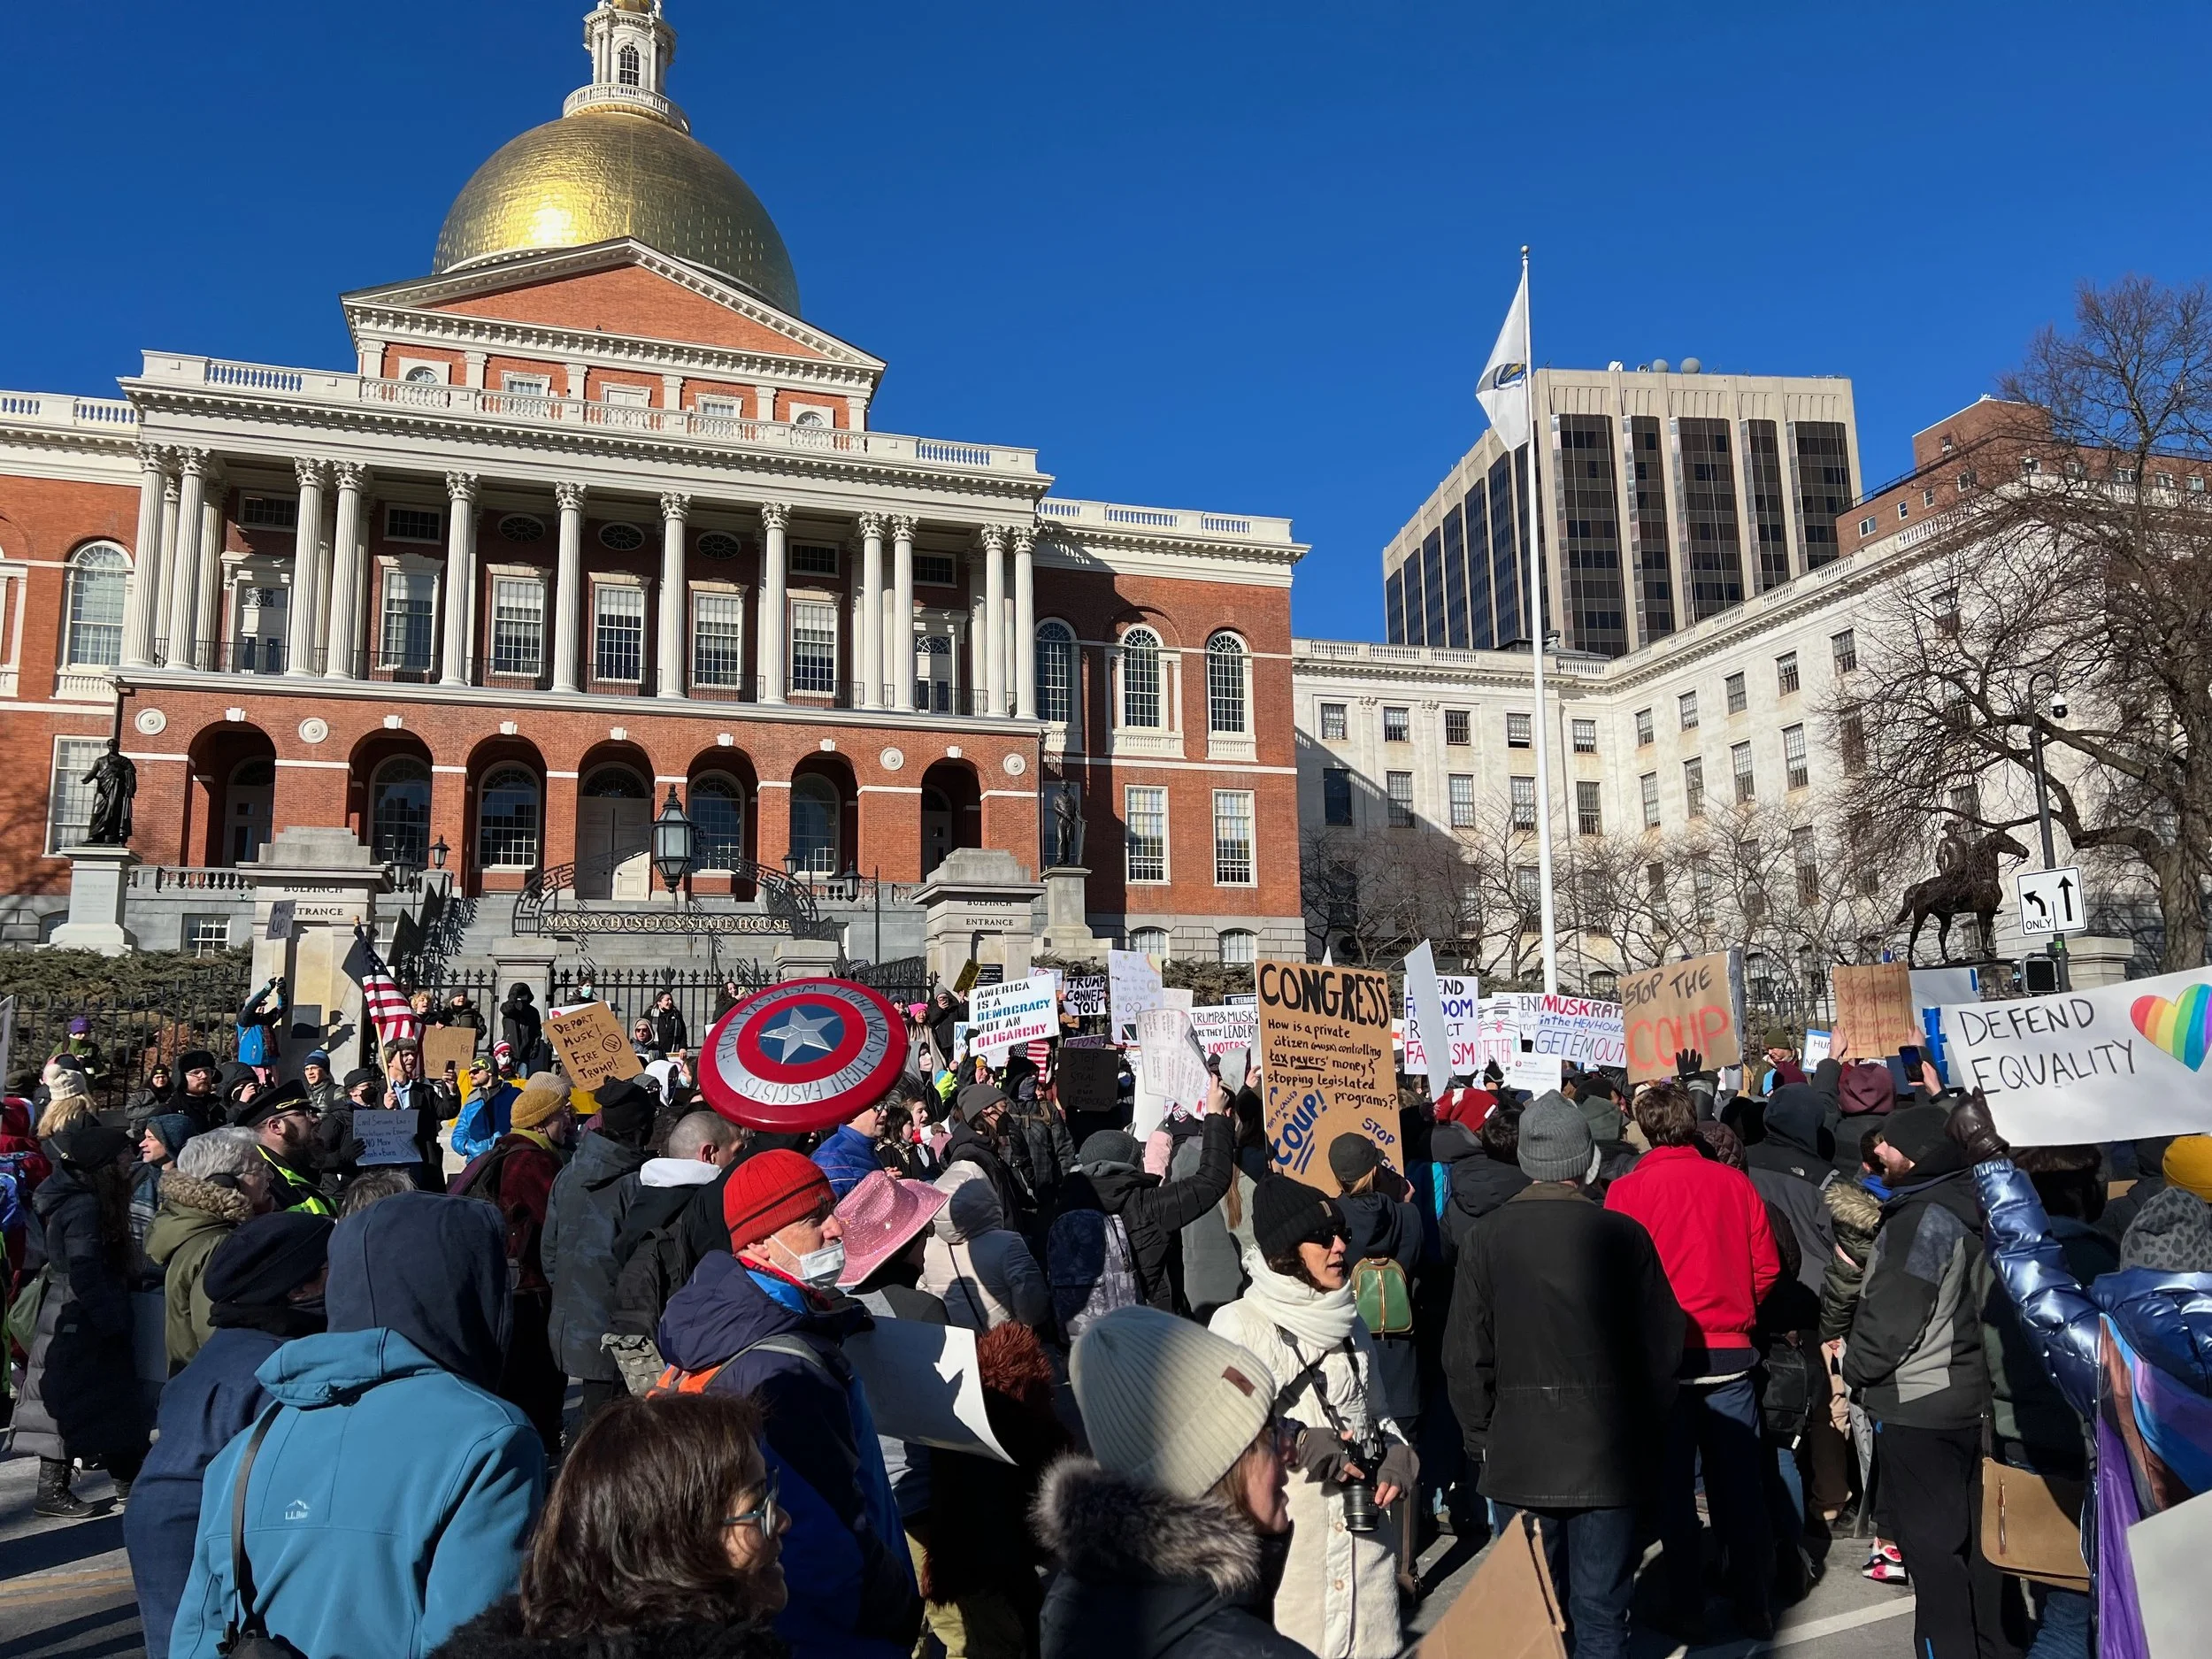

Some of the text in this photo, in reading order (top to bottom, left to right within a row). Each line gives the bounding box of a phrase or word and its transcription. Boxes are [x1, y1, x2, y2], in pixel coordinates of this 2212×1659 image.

[544, 917, 789, 930] MASSACHUSETTS STATE HOUSE
[2025, 918, 2052, 930] ONLY
[977, 981, 1030, 1000] AMERICA
[1066, 976, 1106, 989] TRUMP
[1625, 964, 1712, 1007] STOP THE
[740, 984, 817, 1017] FASCISM
[833, 986, 880, 1011] FIGHT
[977, 998, 1002, 1010] IS A
[1065, 990, 1105, 1002] CONNED
[1260, 964, 1388, 1029] CONGRESS
[1540, 995, 1624, 1020] MUSKRAT
[977, 999, 1051, 1022] DEMOCRACY
[1073, 1002, 1099, 1014] YOU
[553, 1014, 594, 1034] DEPORT
[979, 1016, 1020, 1034] NOT AN
[1268, 1019, 1350, 1040] How is a private
[1958, 999, 2094, 1047] DEFEND
[978, 1024, 1048, 1048] OLIGARCHY
[1535, 1029, 1572, 1056] GET
[1628, 1005, 1729, 1071] COUP
[571, 1050, 599, 1064] FIRE
[1274, 1035, 1309, 1048] citizen
[1339, 1043, 1382, 1061] controlling
[578, 1056, 618, 1079] TRUMP!
[1269, 1048, 1288, 1064] tax
[1333, 1059, 1366, 1077] money
[1971, 1039, 2135, 1094] EQUALITY
[833, 1057, 876, 1094] FIGHT
[1267, 1070, 1376, 1090] stopping legislated
[1334, 1092, 1396, 1110] programs?
[1273, 1089, 1327, 1165] COUP!
[1362, 1118, 1395, 1145] STOP
